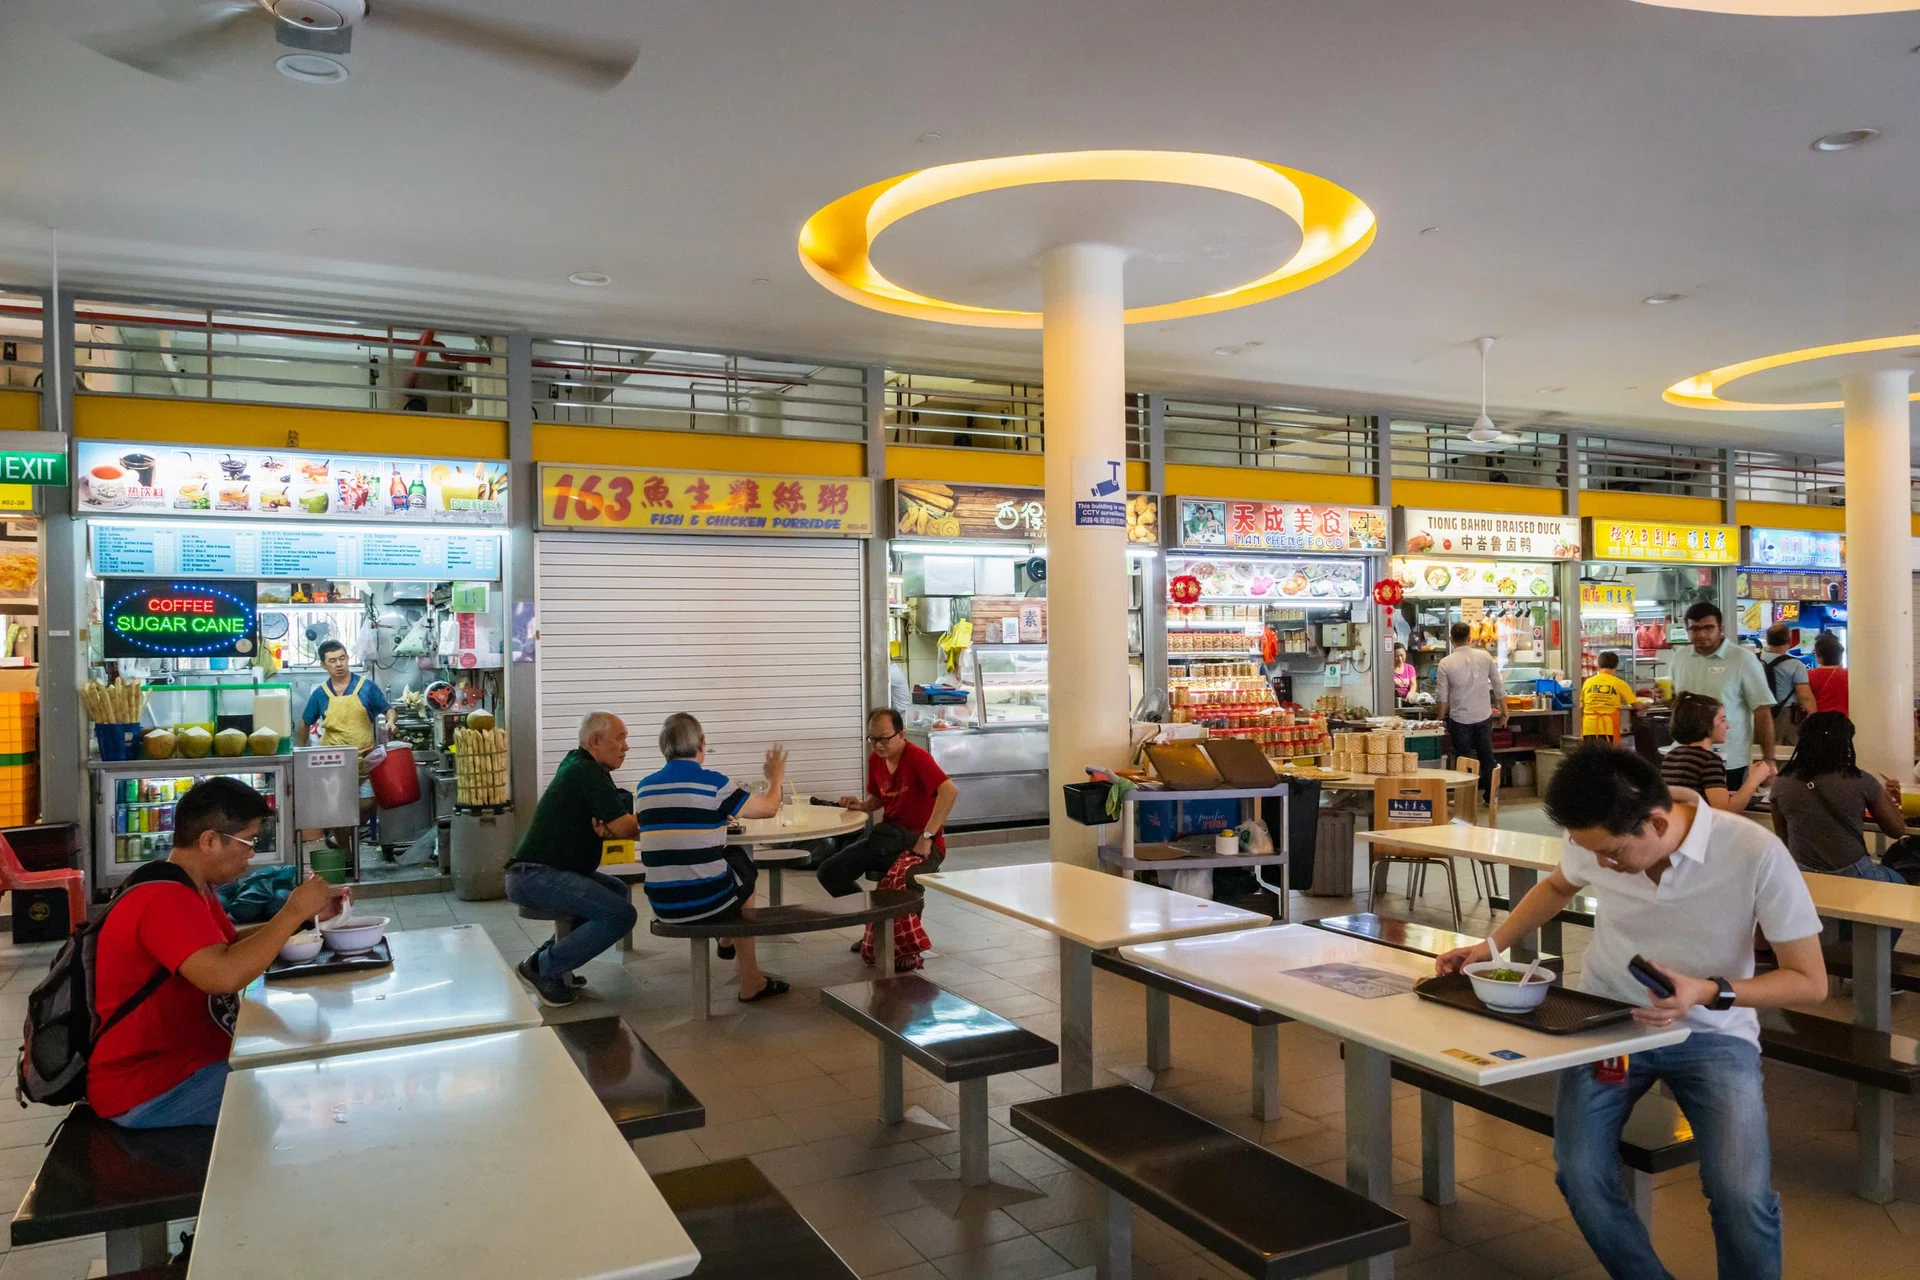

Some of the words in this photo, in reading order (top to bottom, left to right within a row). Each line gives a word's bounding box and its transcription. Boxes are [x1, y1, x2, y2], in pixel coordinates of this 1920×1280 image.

[6, 456, 56, 480] EXIT
[128, 486, 164, 498] 热饮料
[553, 474, 634, 522] 163
[641, 476, 849, 515] 魚生雞絲粥
[1092, 503, 1113, 511] building
[650, 513, 684, 526] FISH
[689, 515, 699, 526] &
[706, 515, 767, 529] CHICKEN
[772, 516, 842, 530] PORRIDGE
[1233, 504, 1342, 537] 天成美食
[1427, 516, 1458, 531] TIONG
[1461, 518, 1493, 532] BAHRU
[1496, 519, 1535, 534] BRAISED
[1537, 522, 1561, 535] DUCK
[1233, 534, 1261, 547] TIAN
[1266, 535, 1303, 549] CHENG
[1307, 535, 1343, 549] FOOD
[1461, 534, 1532, 553] 中峇鲁卤鸭
[148, 599, 214, 613] COFFEE
[117, 616, 188, 632] SUGAR
[192, 617, 245, 633] CANE
[1024, 610, 1038, 628] 素
